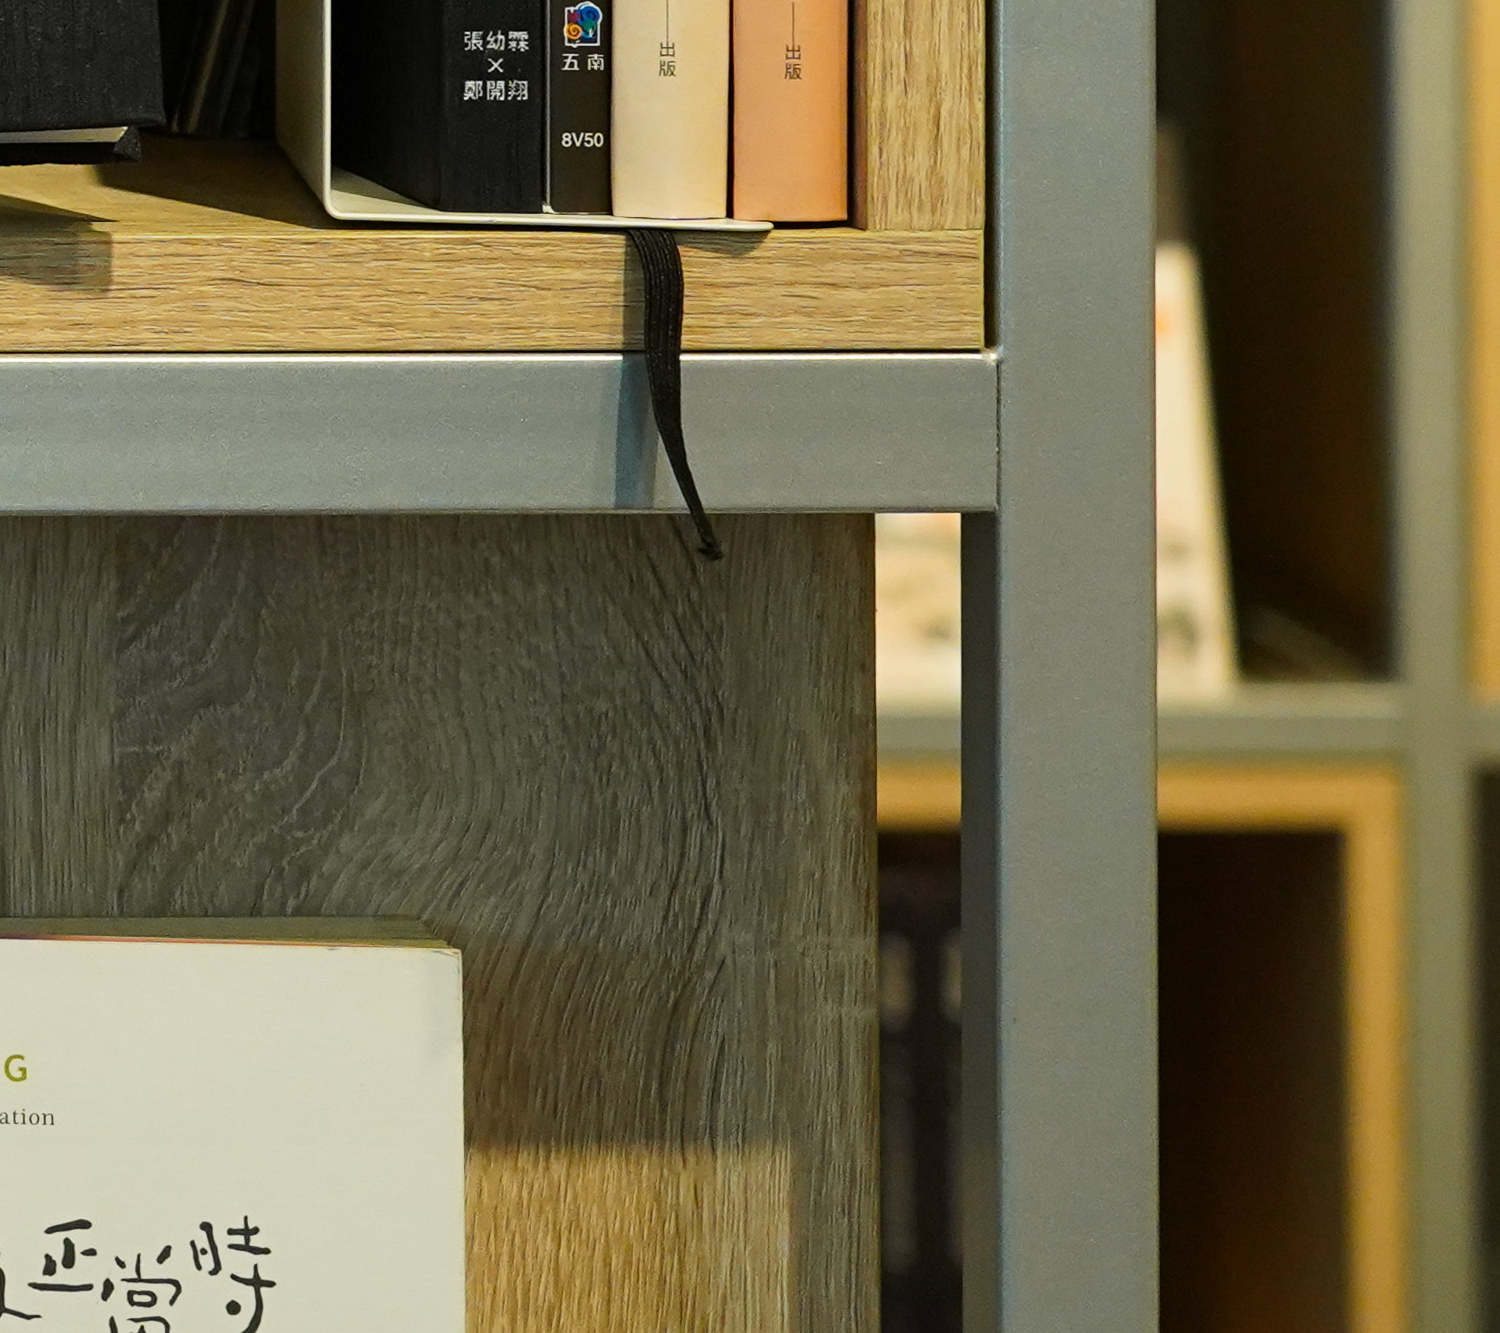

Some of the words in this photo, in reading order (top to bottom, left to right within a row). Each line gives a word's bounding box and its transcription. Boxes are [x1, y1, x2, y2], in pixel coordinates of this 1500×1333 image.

[561, 53, 605, 71] 五南
[463, 80, 529, 101] 鄭開翔
[561, 132, 604, 147] 8V50
